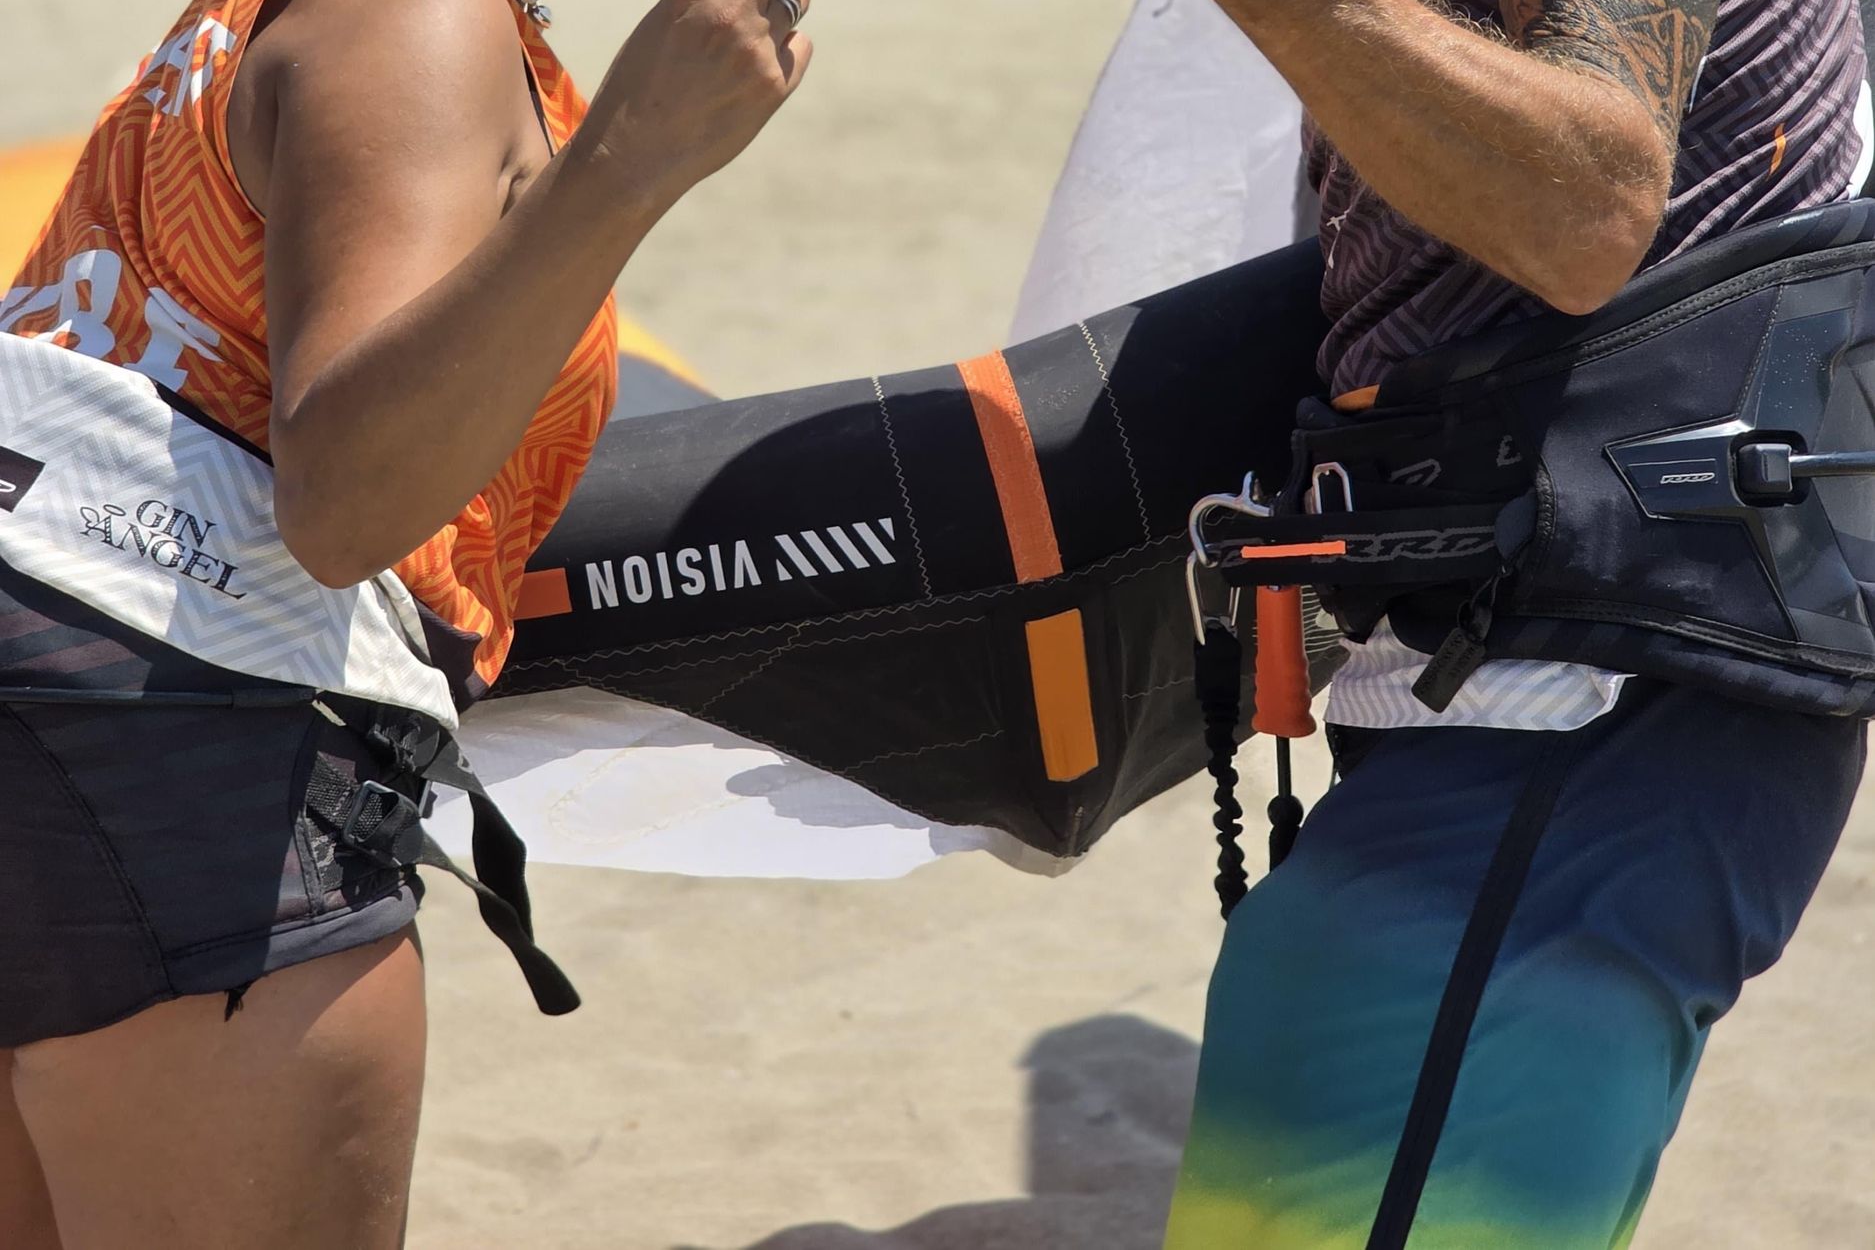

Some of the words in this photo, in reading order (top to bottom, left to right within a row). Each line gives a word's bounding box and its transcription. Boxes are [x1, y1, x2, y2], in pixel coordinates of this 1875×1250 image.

[79, 514, 248, 600] ANGEL
[136, 500, 217, 548] GIN
[585, 540, 762, 610] VISION
